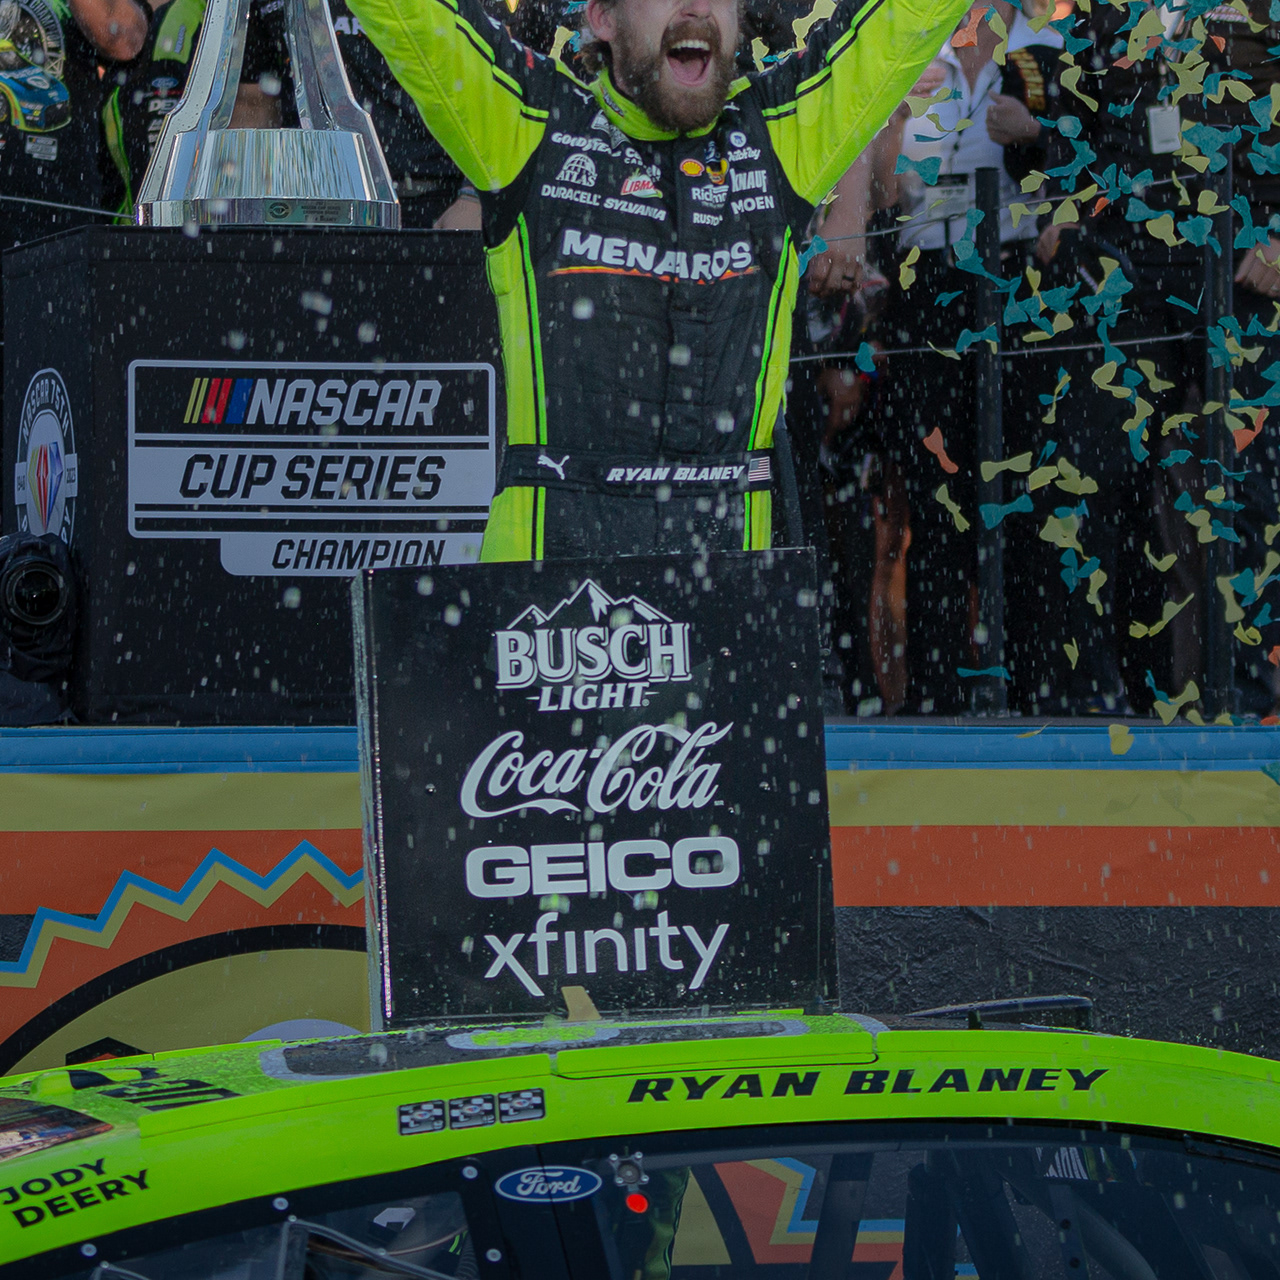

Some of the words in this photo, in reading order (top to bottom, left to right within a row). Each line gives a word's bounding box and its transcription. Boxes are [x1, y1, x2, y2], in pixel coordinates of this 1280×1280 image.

[541, 184, 601, 206] DURACELL
[555, 169, 598, 187] ATLAS
[603, 197, 667, 221] SYLVANIA
[730, 195, 775, 215] MOEN
[561, 229, 753, 281] MENARDS
[246, 378, 442, 426] NASCAR
[179, 453, 278, 500] CUP
[280, 455, 446, 501] SERIES
[606, 466, 670, 482] RYAN
[672, 465, 745, 482] BLANEY
[271, 538, 445, 570] CHAMPION
[494, 622, 693, 690] BUSCH
[538, 682, 650, 711] LIGHT
[460, 721, 734, 818] Coca-Cola
[465, 836, 740, 898] GEICO
[484, 910, 730, 997] xfinity
[626, 1070, 821, 1104] RYAN
[843, 1067, 1110, 1095] BLANEY
[12, 1169, 150, 1229] DEERY
[516, 1169, 585, 1197] Ford
